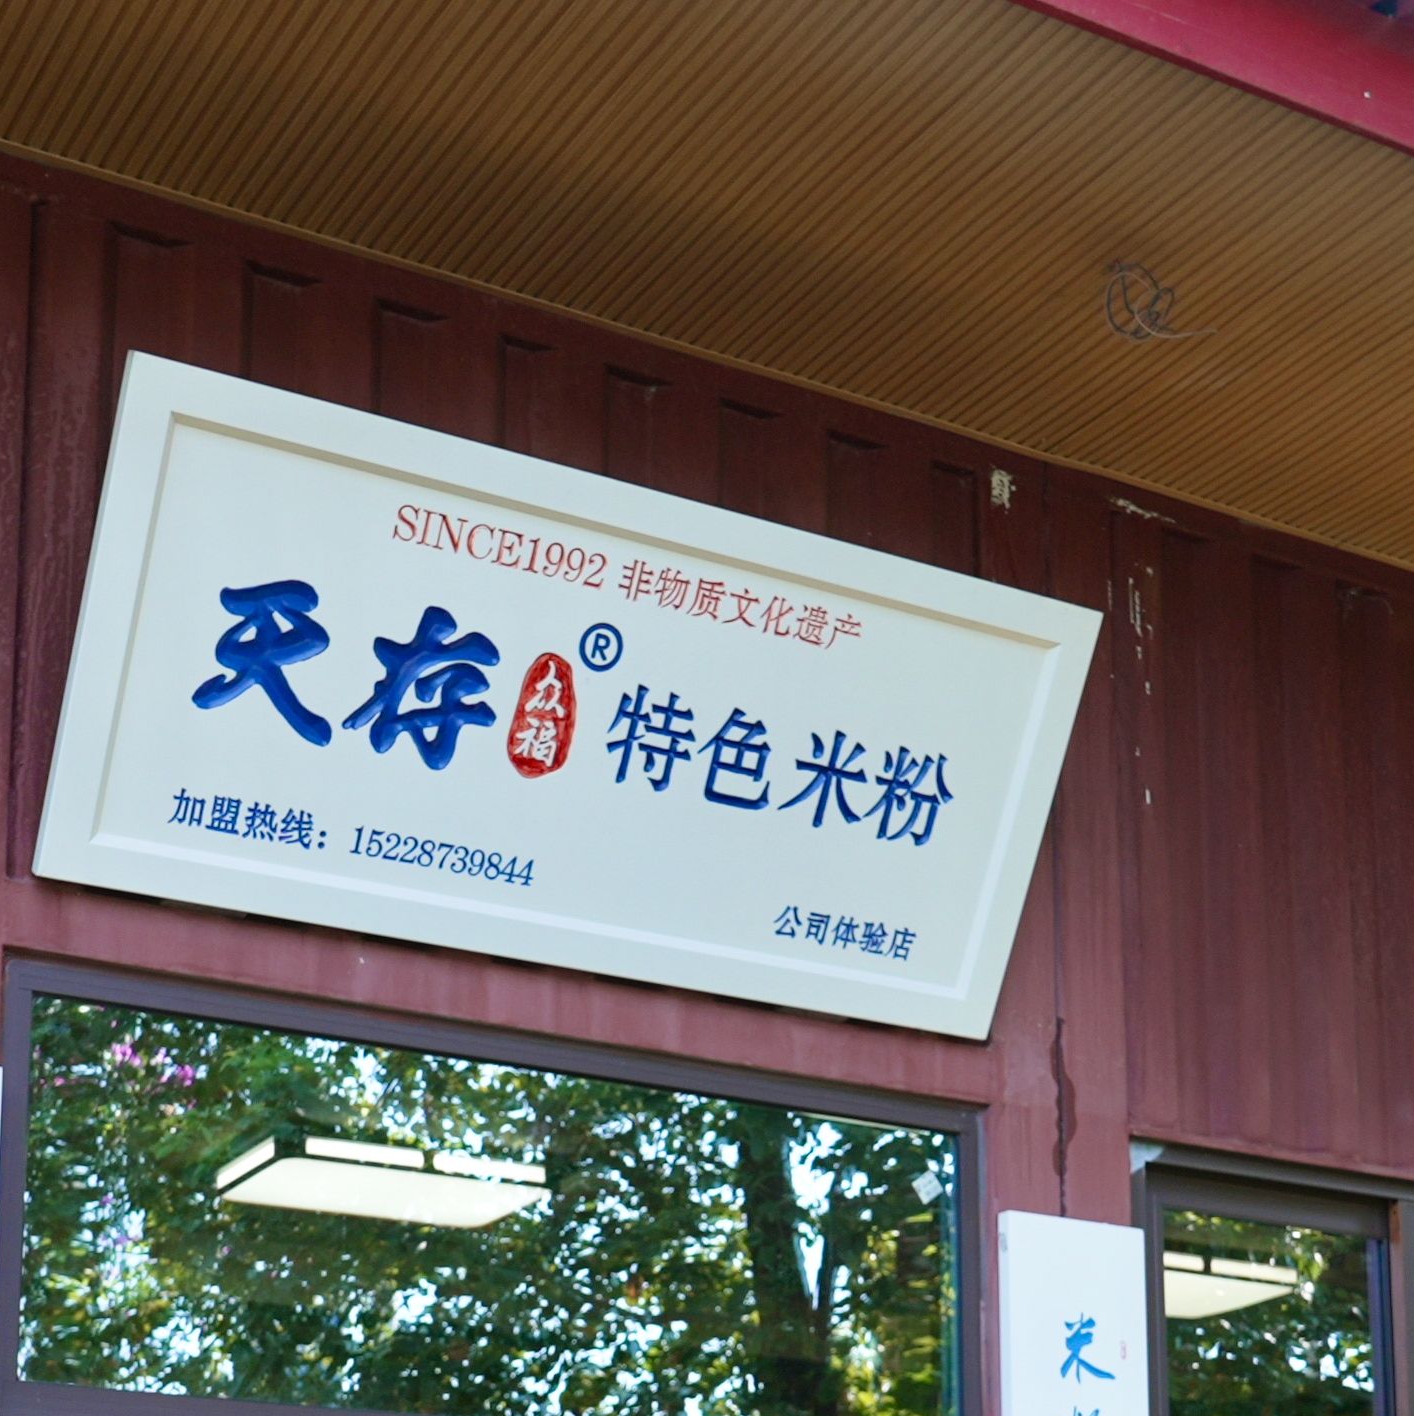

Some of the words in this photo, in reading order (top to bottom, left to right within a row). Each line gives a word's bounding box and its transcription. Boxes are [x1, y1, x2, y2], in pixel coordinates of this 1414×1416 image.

[393, 503, 607, 588] SINCE1992
[618, 558, 863, 648] 非物质文化遗产
[605, 683, 955, 848] 特色米粉
[350, 825, 536, 888] 15228739844
[774, 903, 917, 962] 公司体验店
